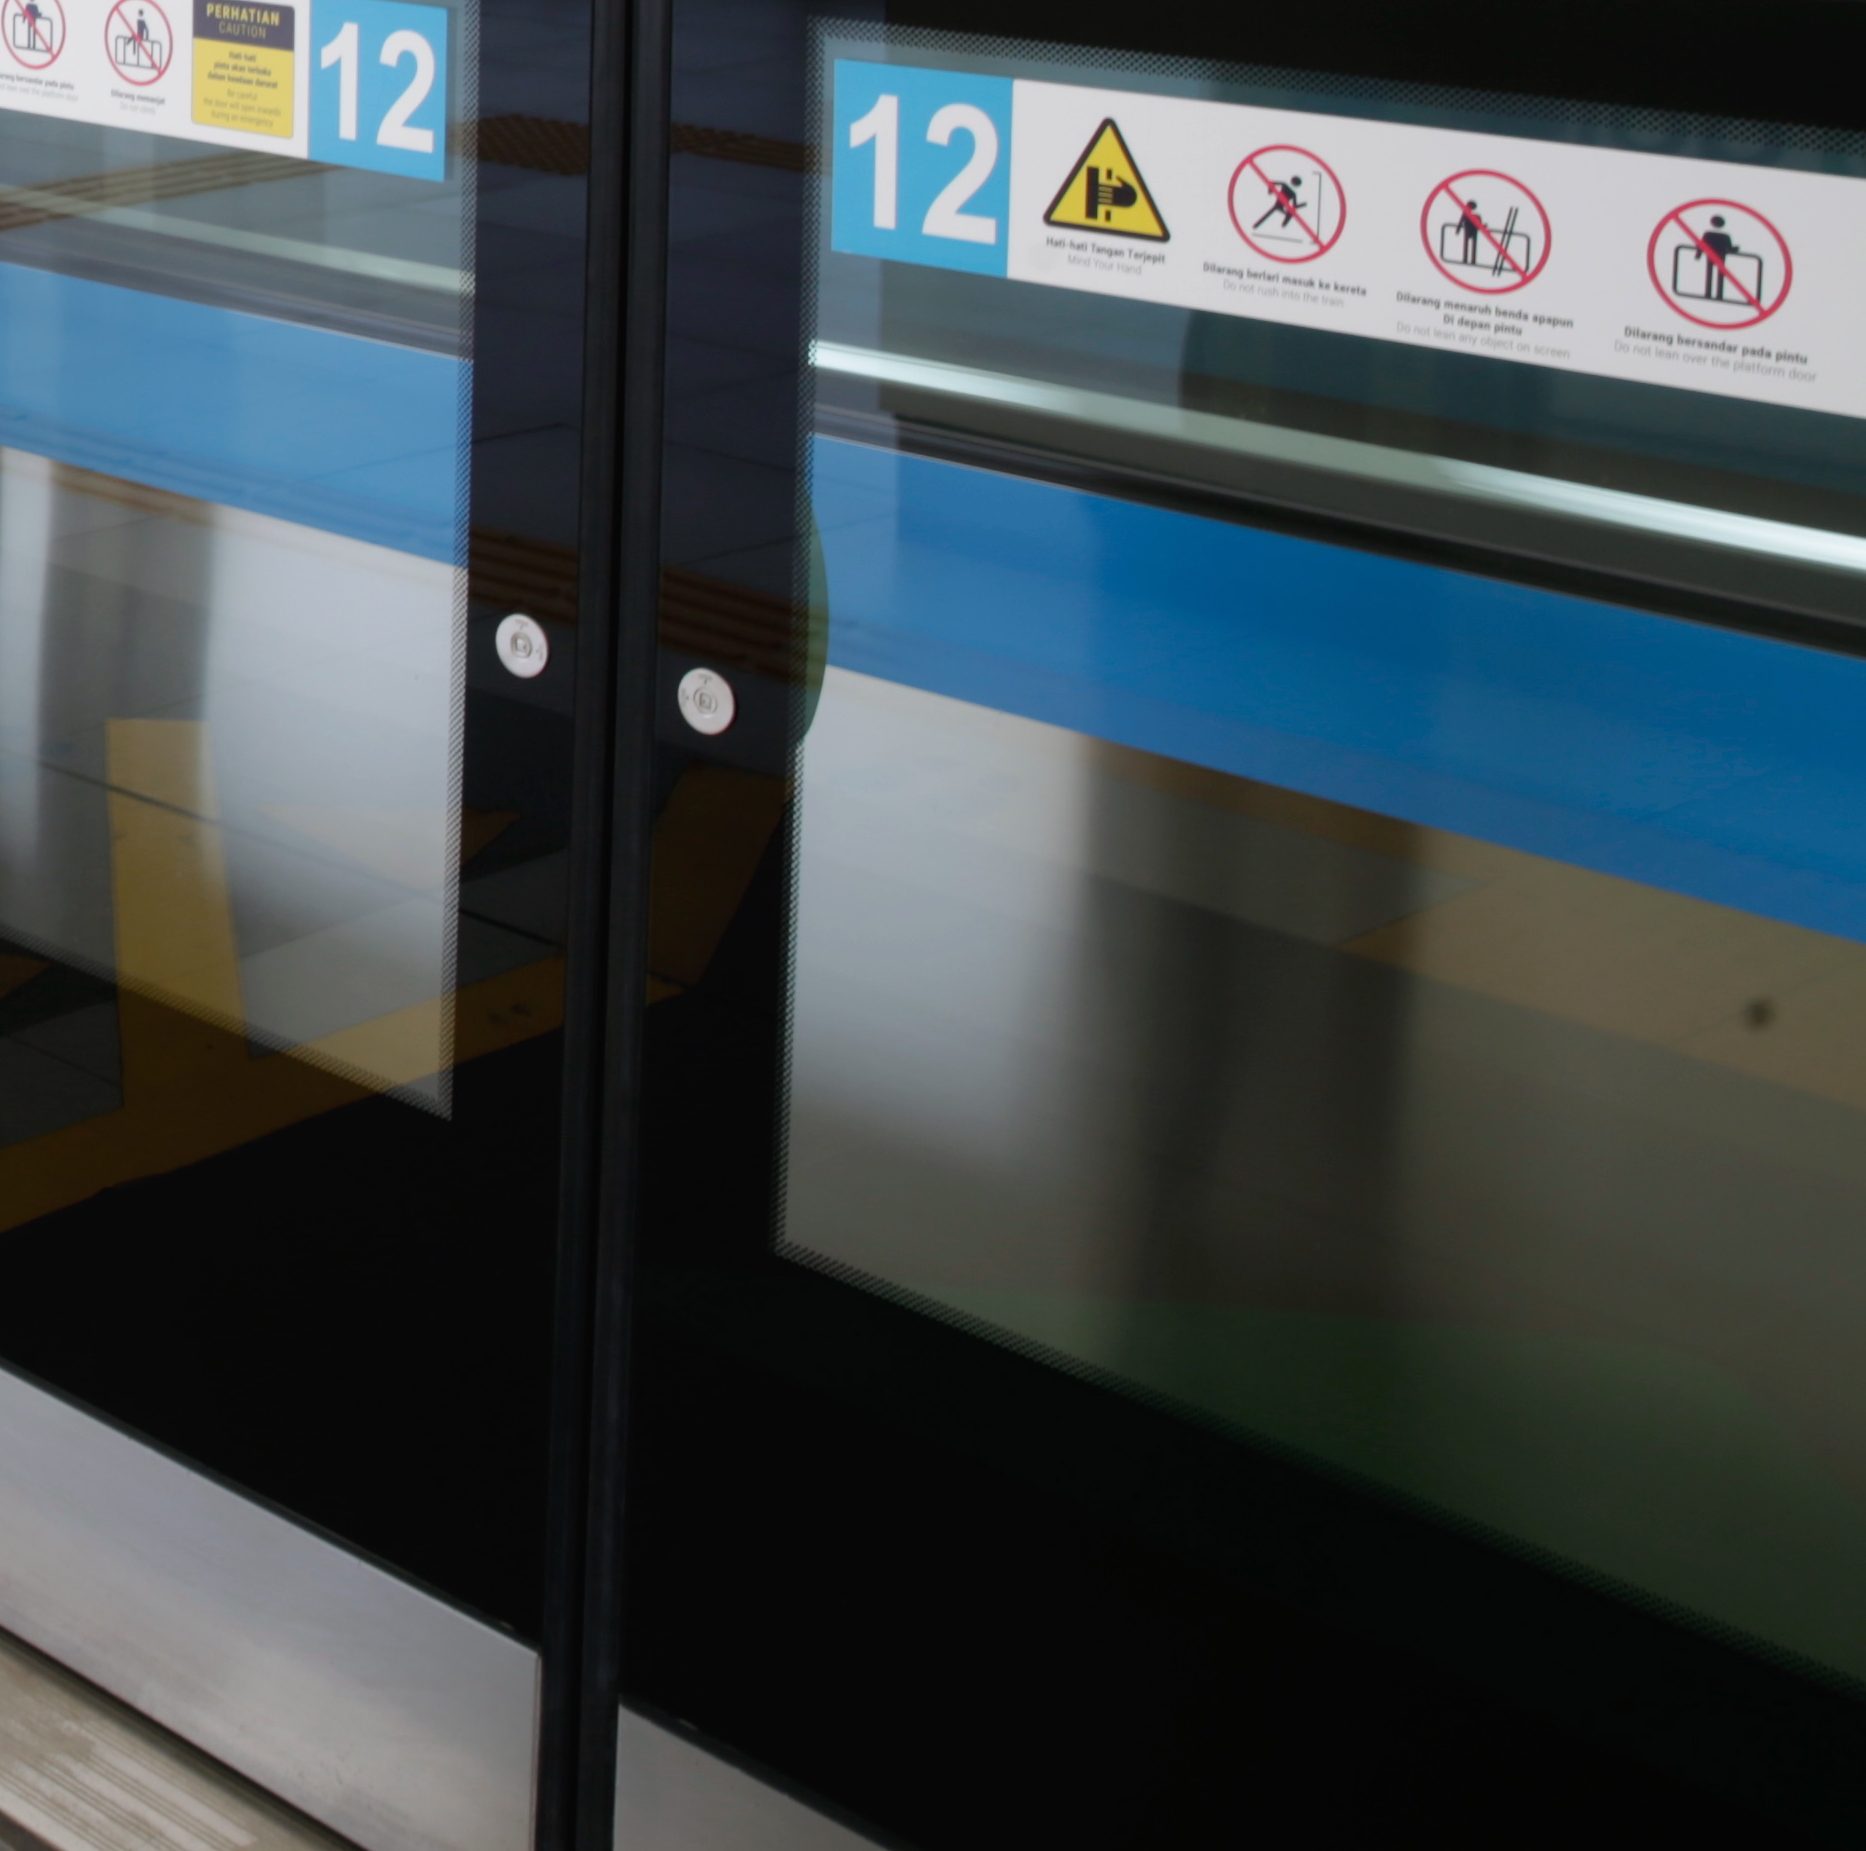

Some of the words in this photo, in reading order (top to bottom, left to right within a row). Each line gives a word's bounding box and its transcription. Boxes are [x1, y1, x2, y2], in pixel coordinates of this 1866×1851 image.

[206, 2, 280, 26] PERHATIAN
[218, 21, 267, 39] CAUTION
[320, 21, 436, 154] 12
[847, 92, 999, 246] 12
[1046, 236, 1088, 253] Hati-hati
[1090, 243, 1125, 260] Tangan
[1128, 248, 1166, 266] Terjepit
[1203, 261, 1244, 280] Dilarang
[1247, 267, 1280, 283] berlari
[1282, 273, 1315, 289] masuk
[1318, 278, 1331, 291] ke
[1334, 281, 1367, 297] kereta
[1396, 290, 1441, 310] Dilarang
[1444, 299, 1492, 316] menaruh
[1495, 305, 1529, 321] benda
[1532, 313, 1574, 330] apapun
[1443, 313, 1454, 325] Di
[1457, 315, 1491, 332] depan
[1494, 322, 1523, 337] pintu
[1624, 325, 1674, 346] Dilarang
[1676, 333, 1739, 355] bersandar
[1741, 342, 1771, 359] pada
[1775, 349, 1808, 366] pintu
